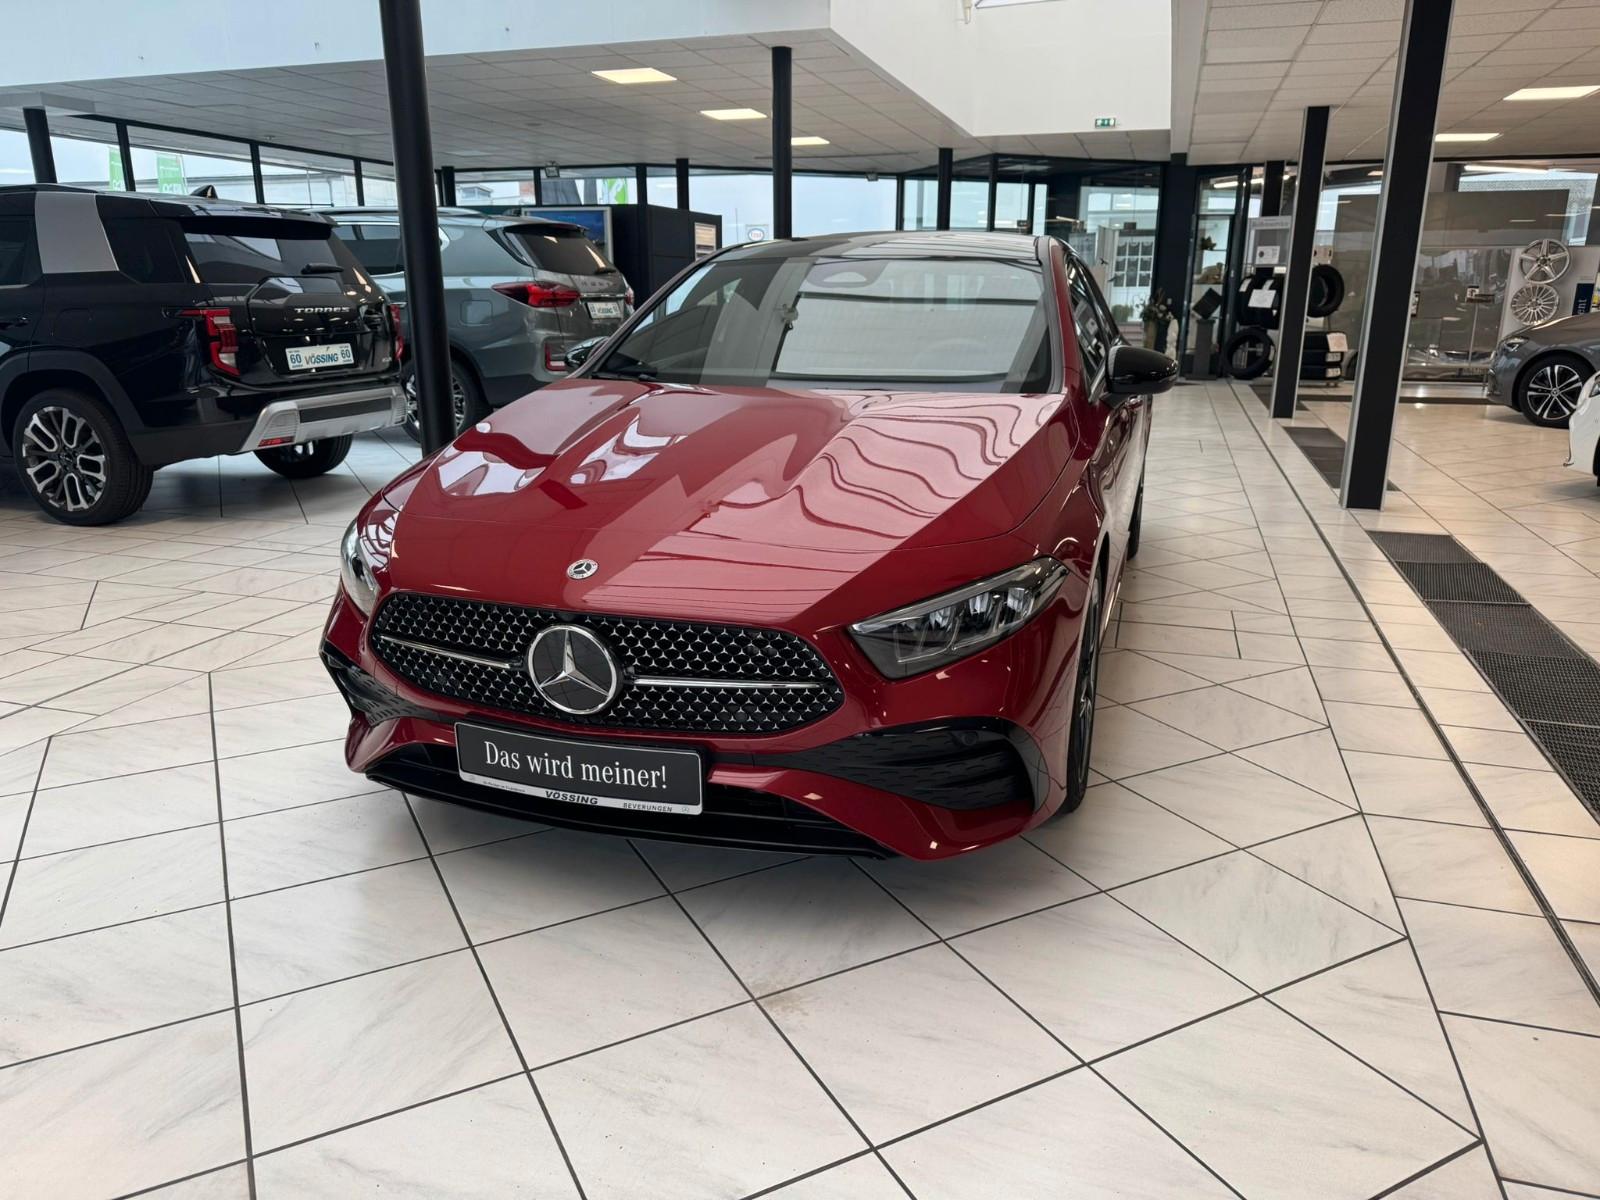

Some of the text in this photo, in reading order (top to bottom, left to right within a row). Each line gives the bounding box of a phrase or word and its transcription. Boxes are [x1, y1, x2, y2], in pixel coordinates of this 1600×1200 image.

[294, 306, 350, 314] TORRES
[290, 353, 302, 364] 60
[340, 348, 351, 359] 60
[484, 741, 667, 789] Das wird meiner!
[623, 802, 673, 812] BEVERUNGEN
